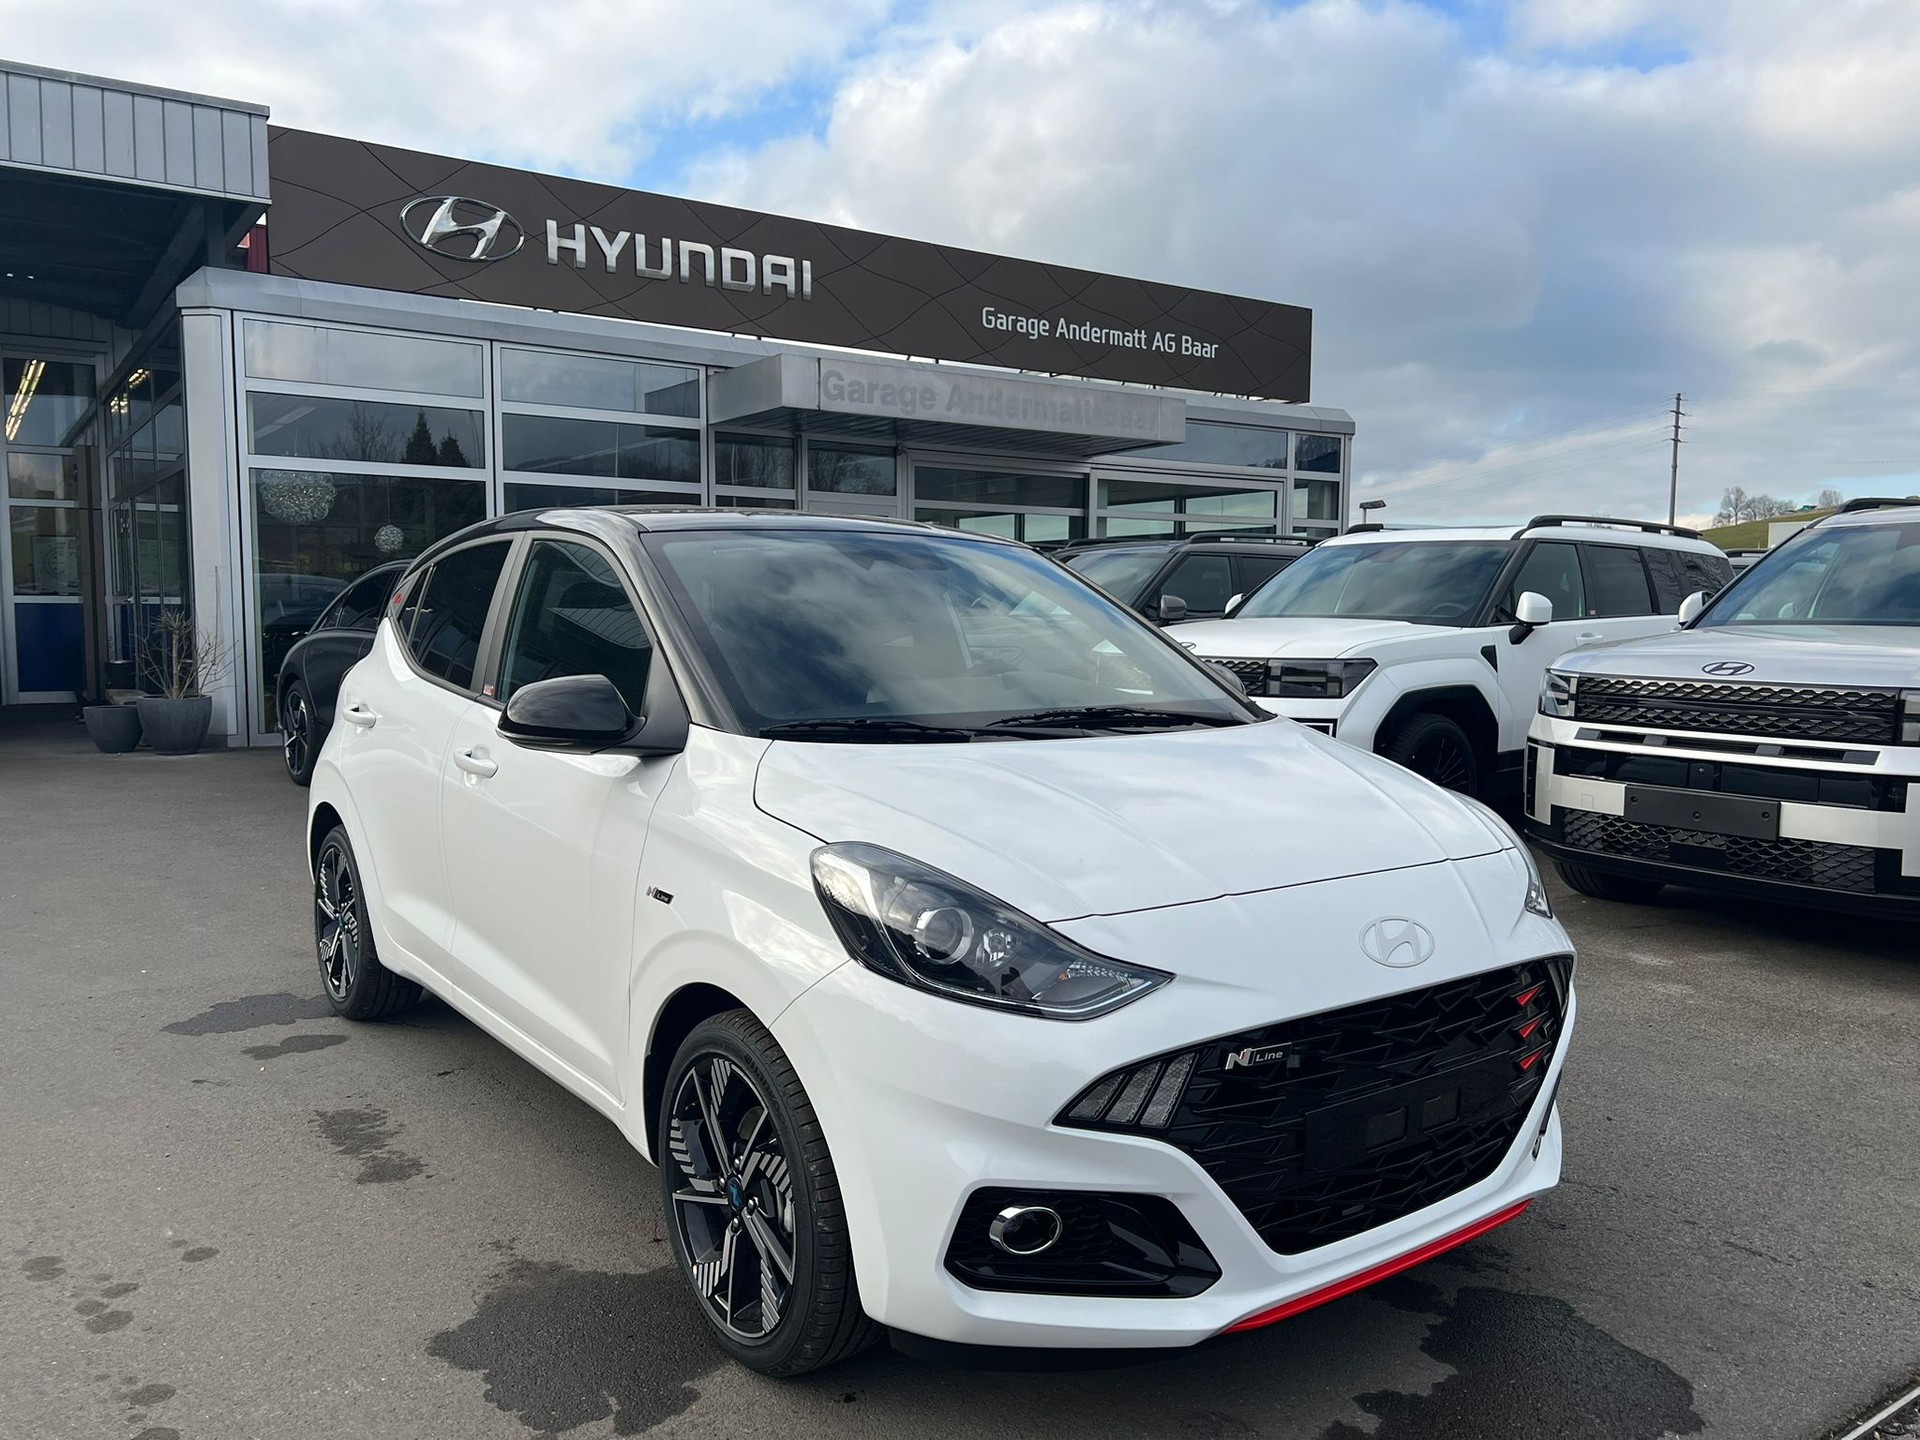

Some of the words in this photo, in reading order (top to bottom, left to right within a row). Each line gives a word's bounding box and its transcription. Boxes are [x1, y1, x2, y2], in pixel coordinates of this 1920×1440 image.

[545, 218, 812, 300] HYUNDAI
[982, 306, 1049, 339] Garage
[1055, 317, 1147, 350] Andermatt
[1152, 331, 1176, 353] AG
[1181, 335, 1219, 359] Baar
[821, 369, 936, 416] Garage
[944, 383, 1093, 426] Andermatt
[1255, 1051, 1283, 1062] Line
